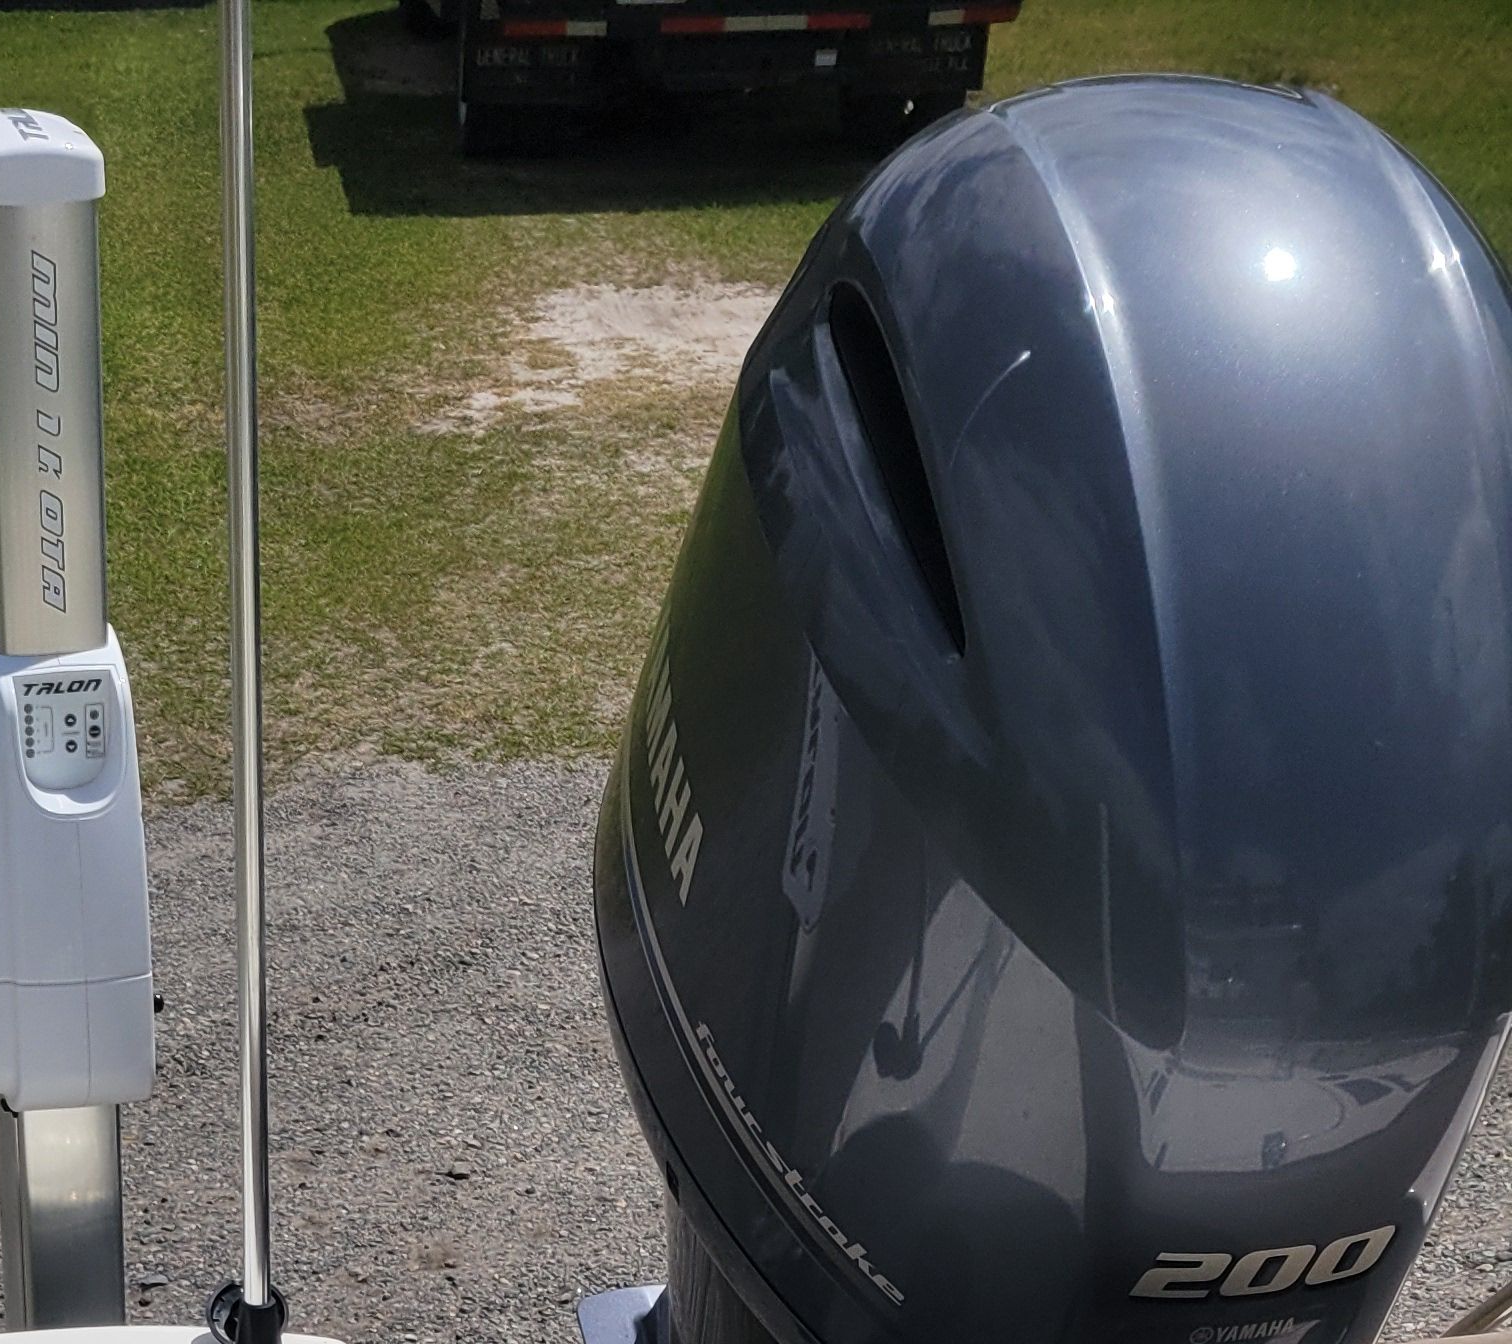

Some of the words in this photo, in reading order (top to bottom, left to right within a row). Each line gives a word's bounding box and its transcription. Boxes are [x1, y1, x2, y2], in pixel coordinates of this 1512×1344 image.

[22, 678, 102, 696] TALON
[1129, 1225, 1395, 1298] 200
[1215, 1317, 1295, 1343] YAMAHA
